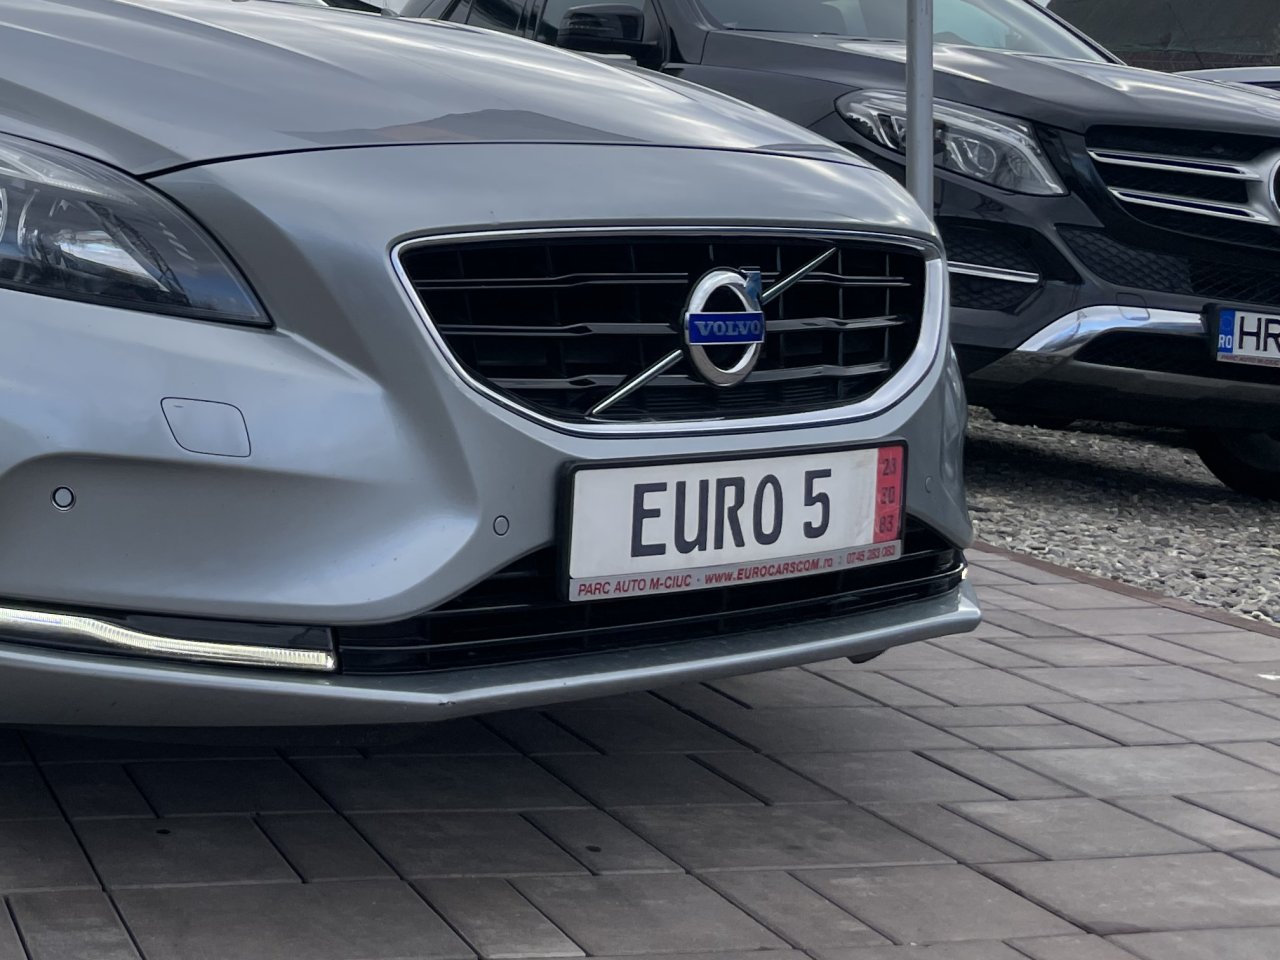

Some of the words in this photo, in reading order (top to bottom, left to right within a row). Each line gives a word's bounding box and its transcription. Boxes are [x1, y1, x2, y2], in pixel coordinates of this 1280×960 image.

[693, 320, 760, 337] VOLVO
[1238, 316, 1280, 354] HR
[1218, 334, 1232, 349] RO
[631, 474, 784, 558] EURO
[803, 469, 832, 539] 5
[578, 581, 611, 597] PARC
[614, 577, 647, 594] AUTO
[649, 574, 693, 590] M-CIUC
